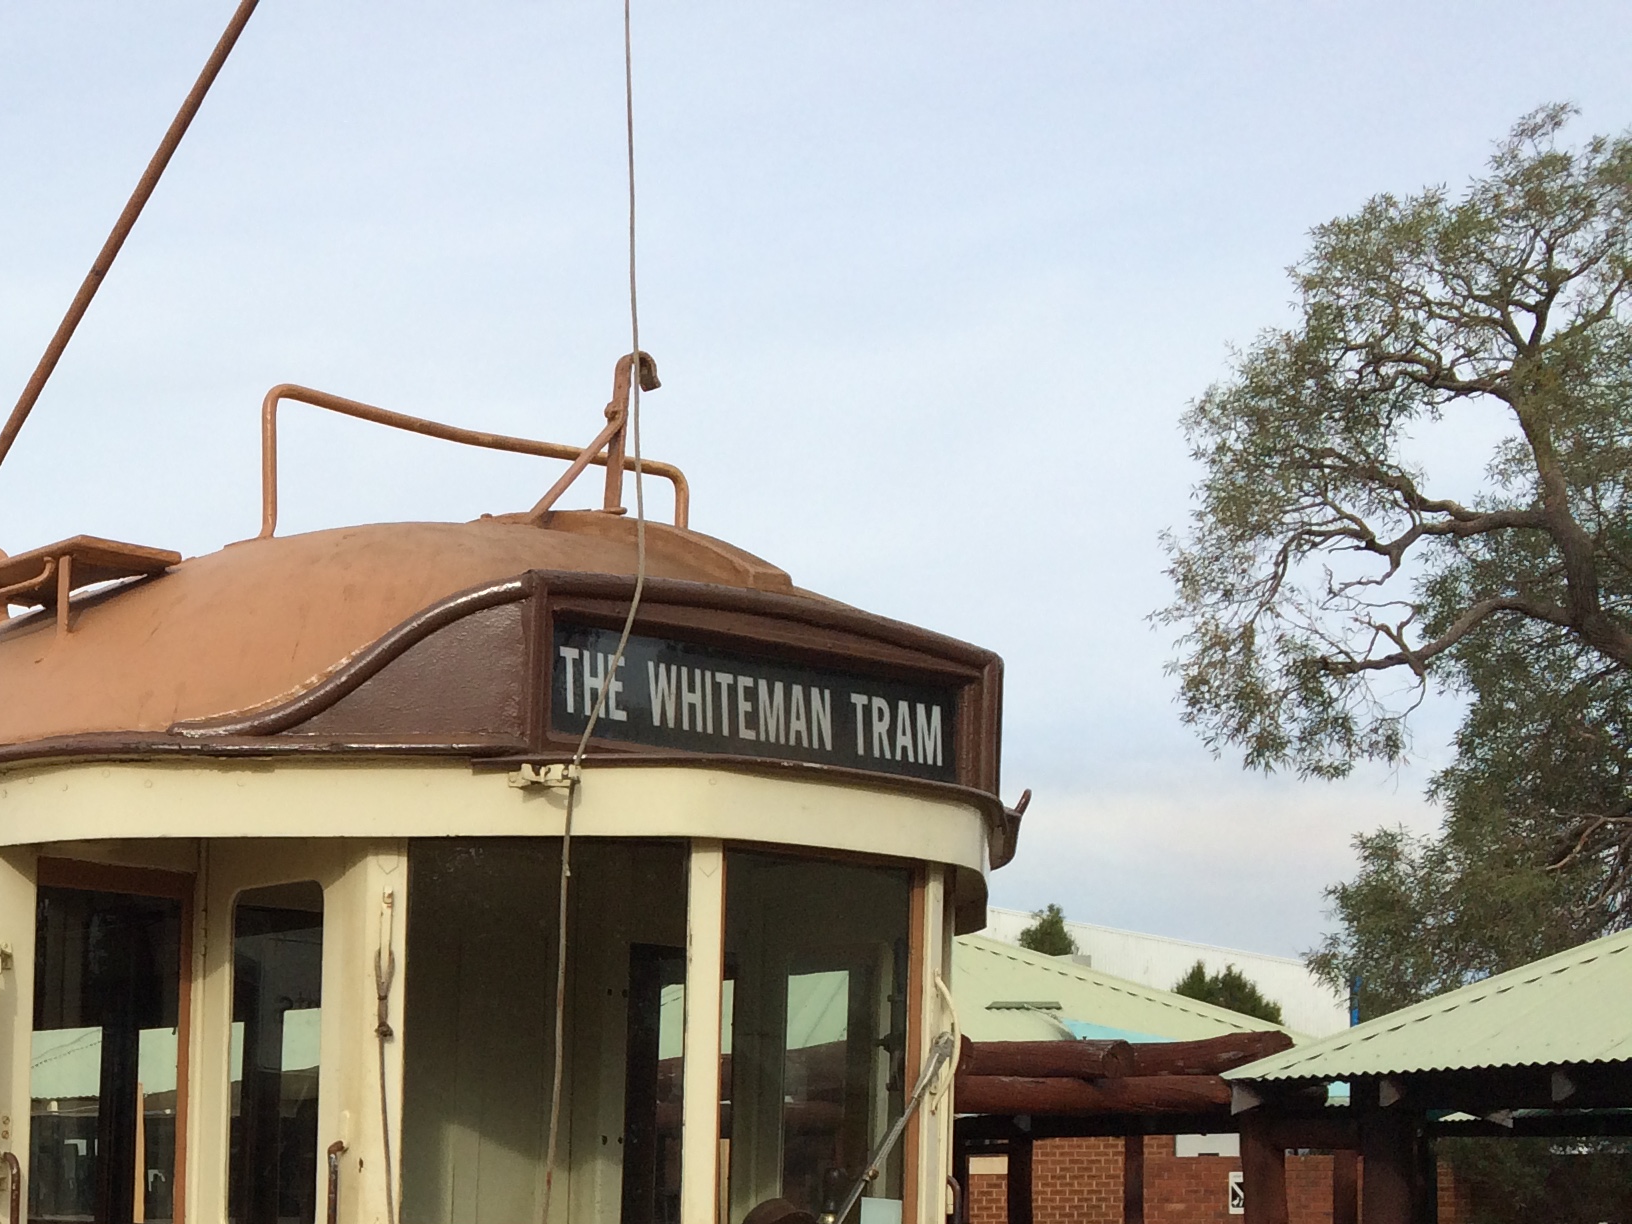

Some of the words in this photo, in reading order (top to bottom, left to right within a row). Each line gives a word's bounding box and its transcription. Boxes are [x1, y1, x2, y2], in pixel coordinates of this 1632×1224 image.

[559, 645, 628, 723] THE
[646, 660, 833, 752] WHITEMAN
[850, 692, 944, 767] TRAM
